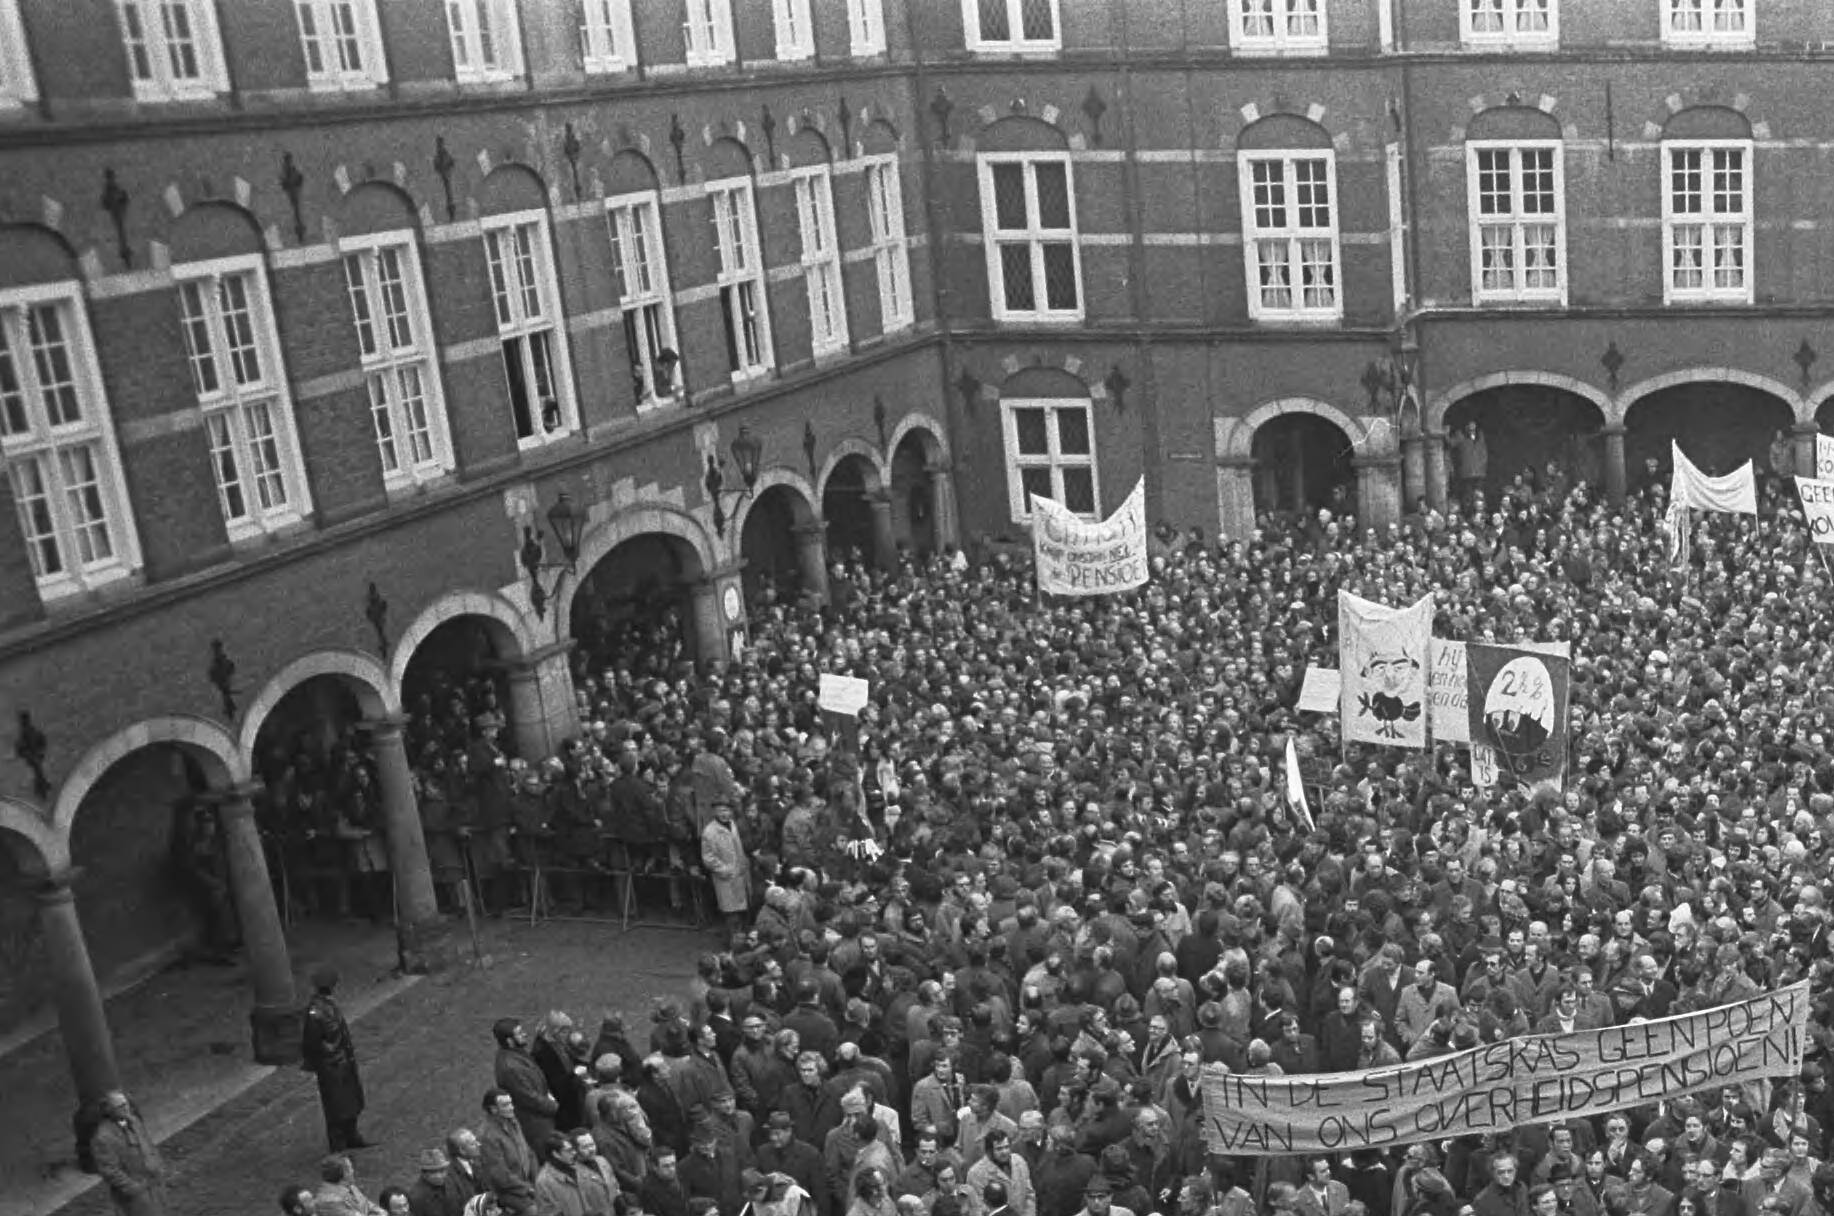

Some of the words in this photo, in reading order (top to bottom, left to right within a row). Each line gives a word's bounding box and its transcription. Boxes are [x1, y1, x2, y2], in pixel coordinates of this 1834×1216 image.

[1224, 1074, 1267, 1108] IN
[1289, 1077, 1342, 1107] DE
[1362, 1033, 1580, 1102] STAATSKAS
[1597, 1018, 1694, 1063] GEEN
[1706, 993, 1794, 1047] POEN
[1213, 1117, 1292, 1151] VAN
[1318, 1108, 1397, 1147] ONS
